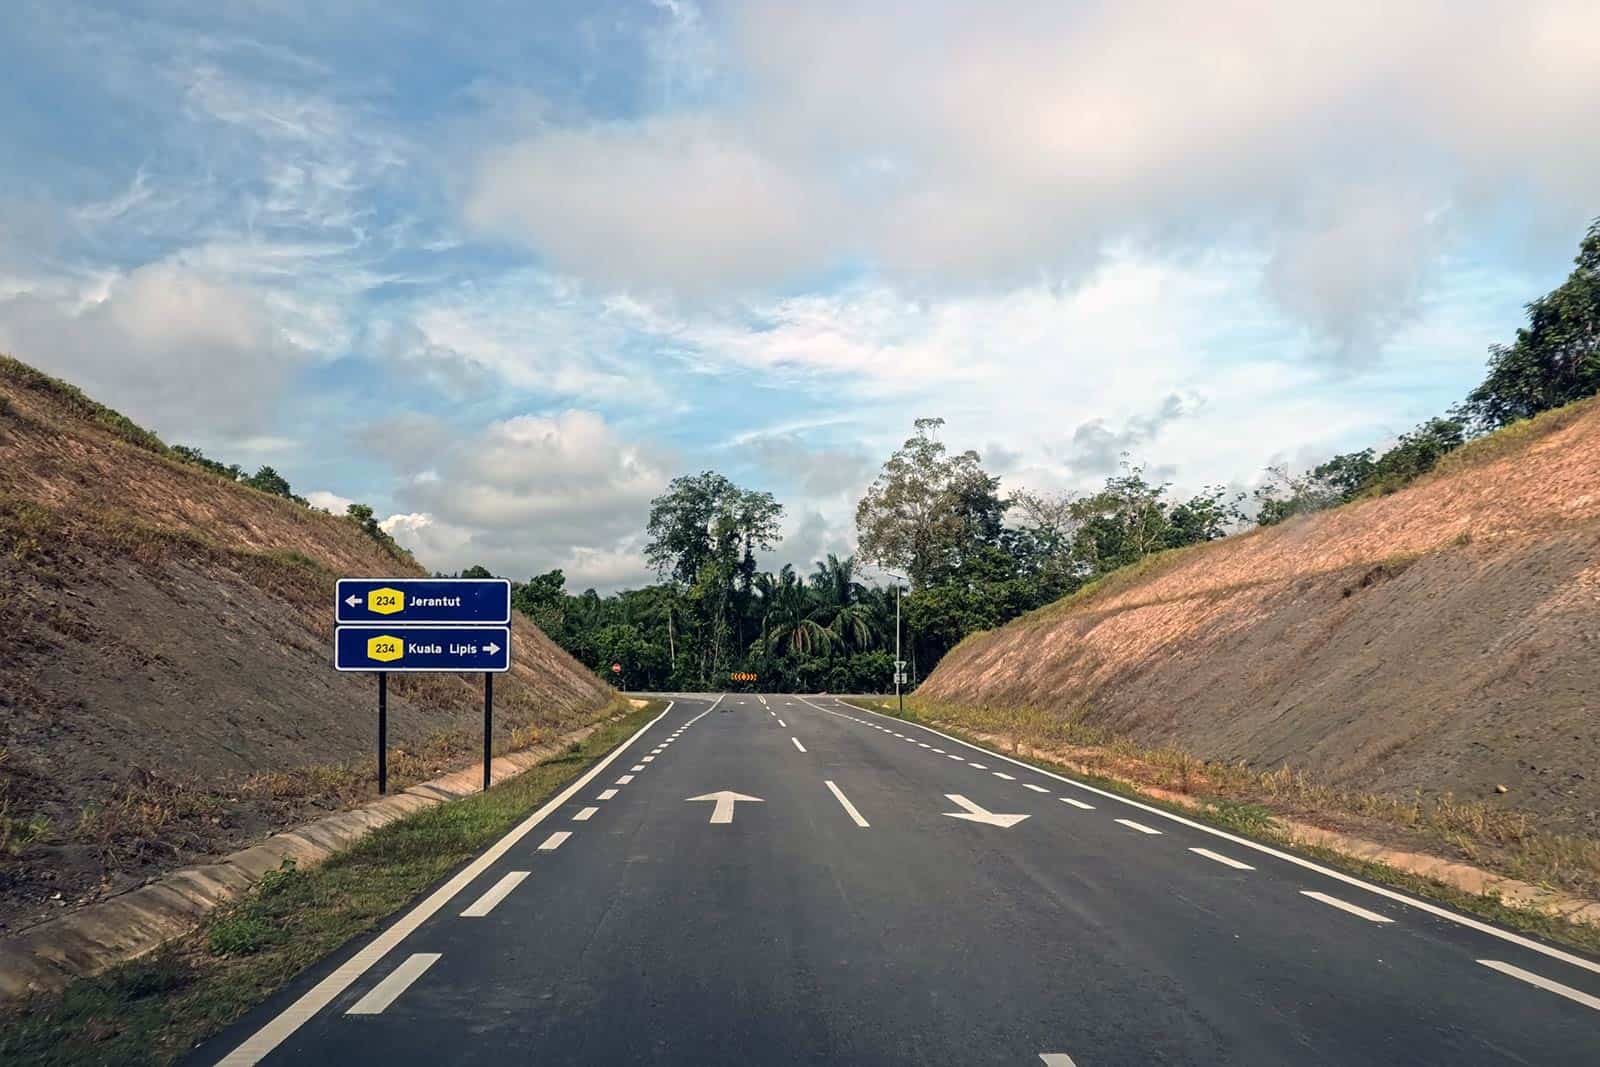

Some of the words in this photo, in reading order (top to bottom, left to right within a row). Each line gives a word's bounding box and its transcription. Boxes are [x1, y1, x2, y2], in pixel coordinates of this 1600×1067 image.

[376, 596, 396, 606] 234
[409, 596, 461, 607] Jerantut
[375, 643, 395, 653] 234
[408, 643, 442, 654] Kuala
[449, 643, 478, 656] Lipis
